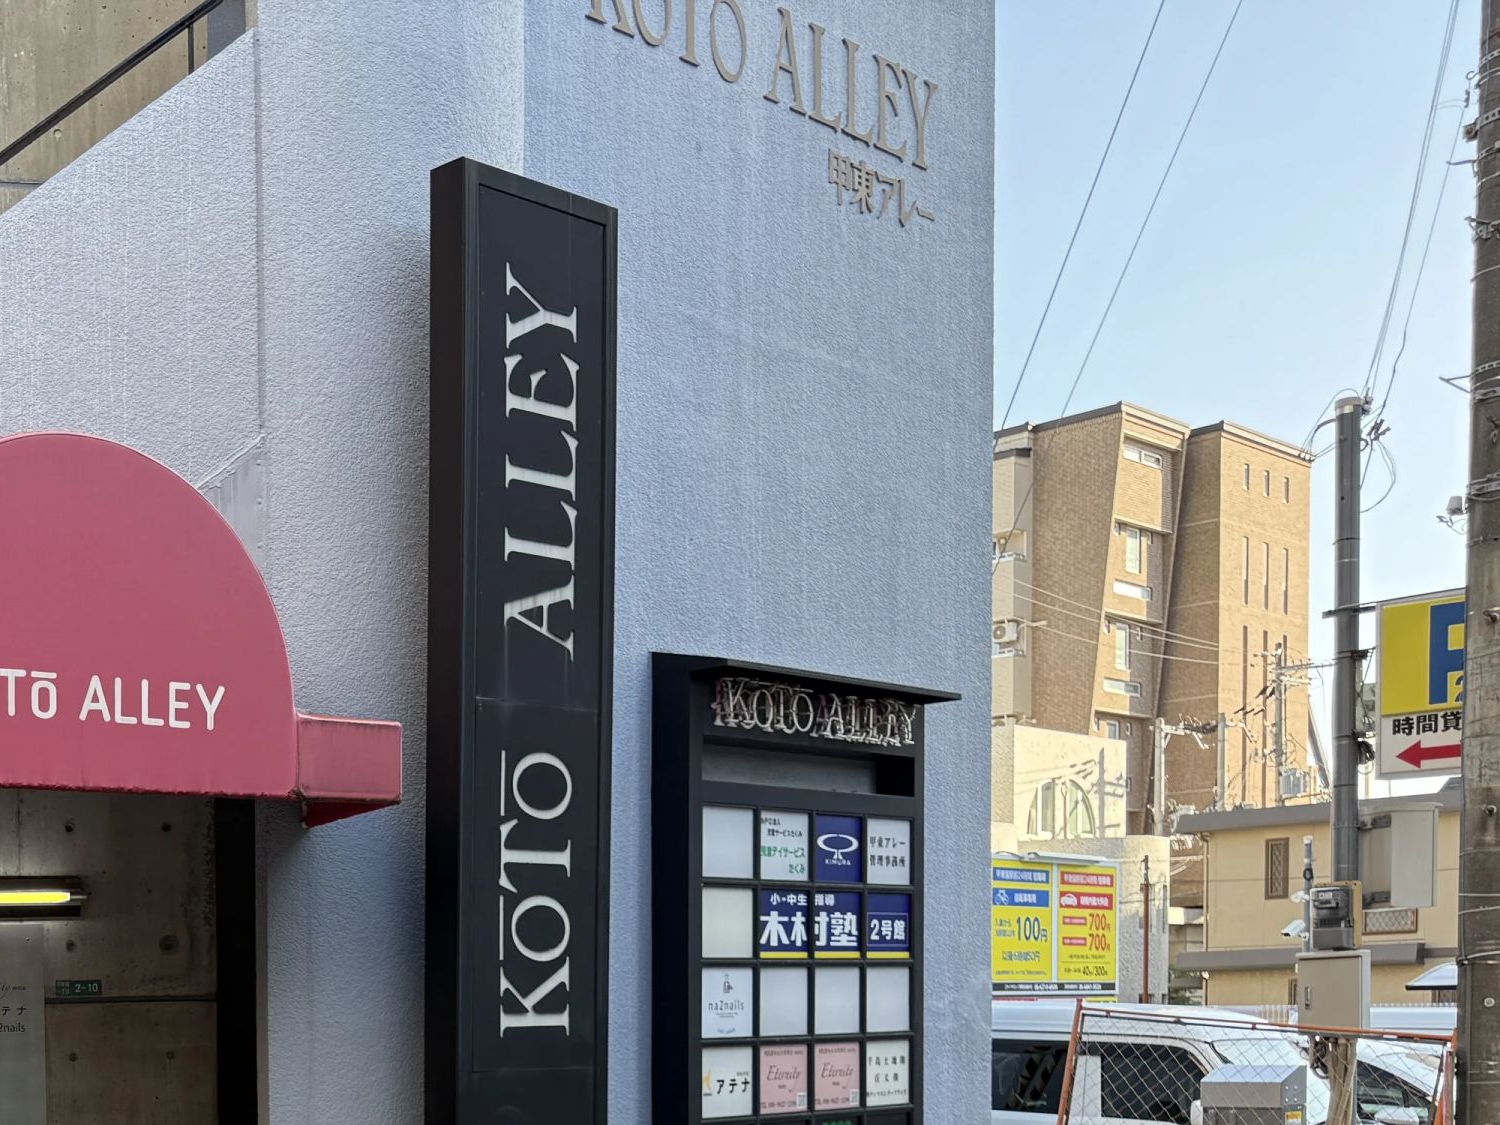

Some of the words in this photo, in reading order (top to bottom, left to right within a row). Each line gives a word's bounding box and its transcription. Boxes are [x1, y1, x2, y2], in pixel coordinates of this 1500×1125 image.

[763, 6, 938, 171] ALLEY
[828, 148, 934, 228] 甲東アレー
[503, 261, 580, 662] ALLEY
[79, 675, 225, 731] ALLEY
[824, 858, 851, 867] KIMURA
[870, 919, 906, 941] 2号館
[75, 983, 98, 993] 2-10
[708, 999, 744, 1011] na2nails
[716, 1078, 750, 1095] アテナ
